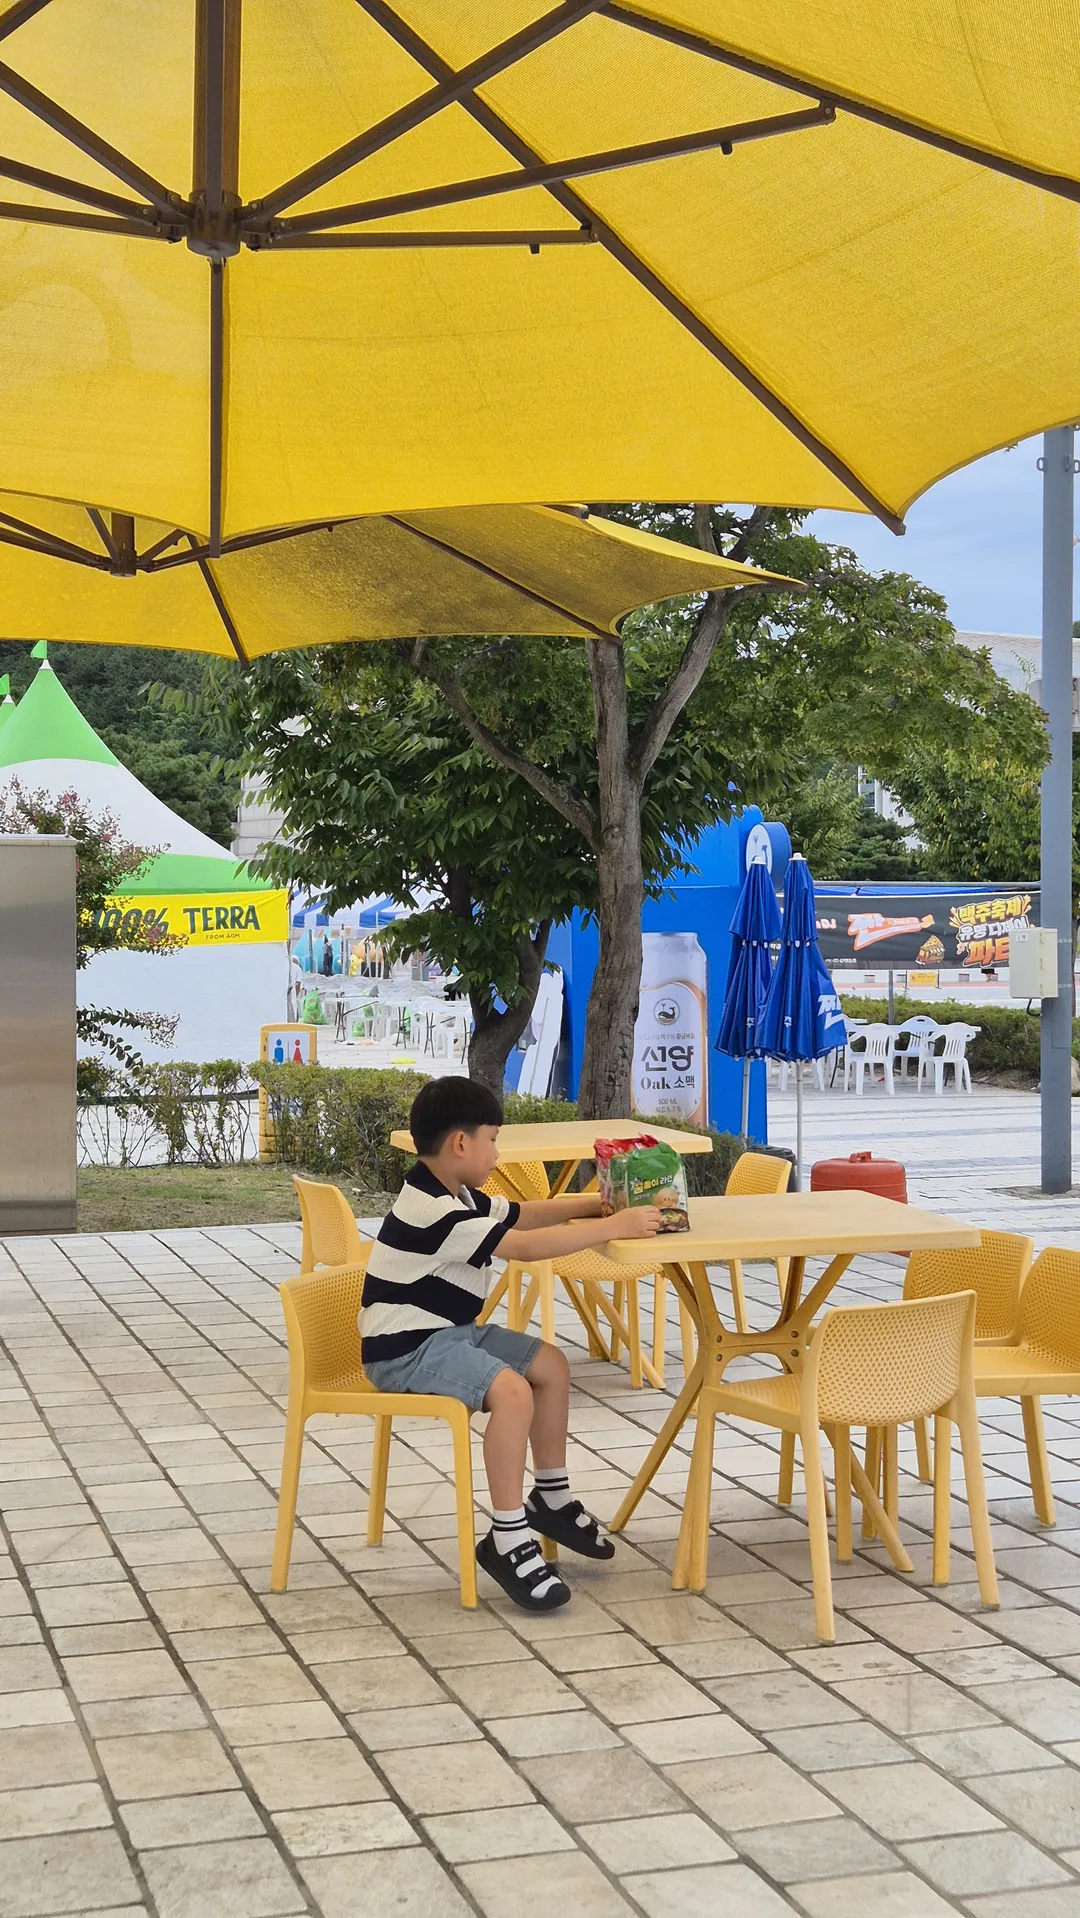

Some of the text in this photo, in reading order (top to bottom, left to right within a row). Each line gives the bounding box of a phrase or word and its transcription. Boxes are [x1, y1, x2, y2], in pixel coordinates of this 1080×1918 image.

[182, 904, 261, 935] TERRA
[959, 896, 1022, 924] 맥주축제
[959, 923, 988, 941] 유명
[641, 1045, 694, 1072] 선양
[640, 1075, 695, 1090] Oak 소맥
